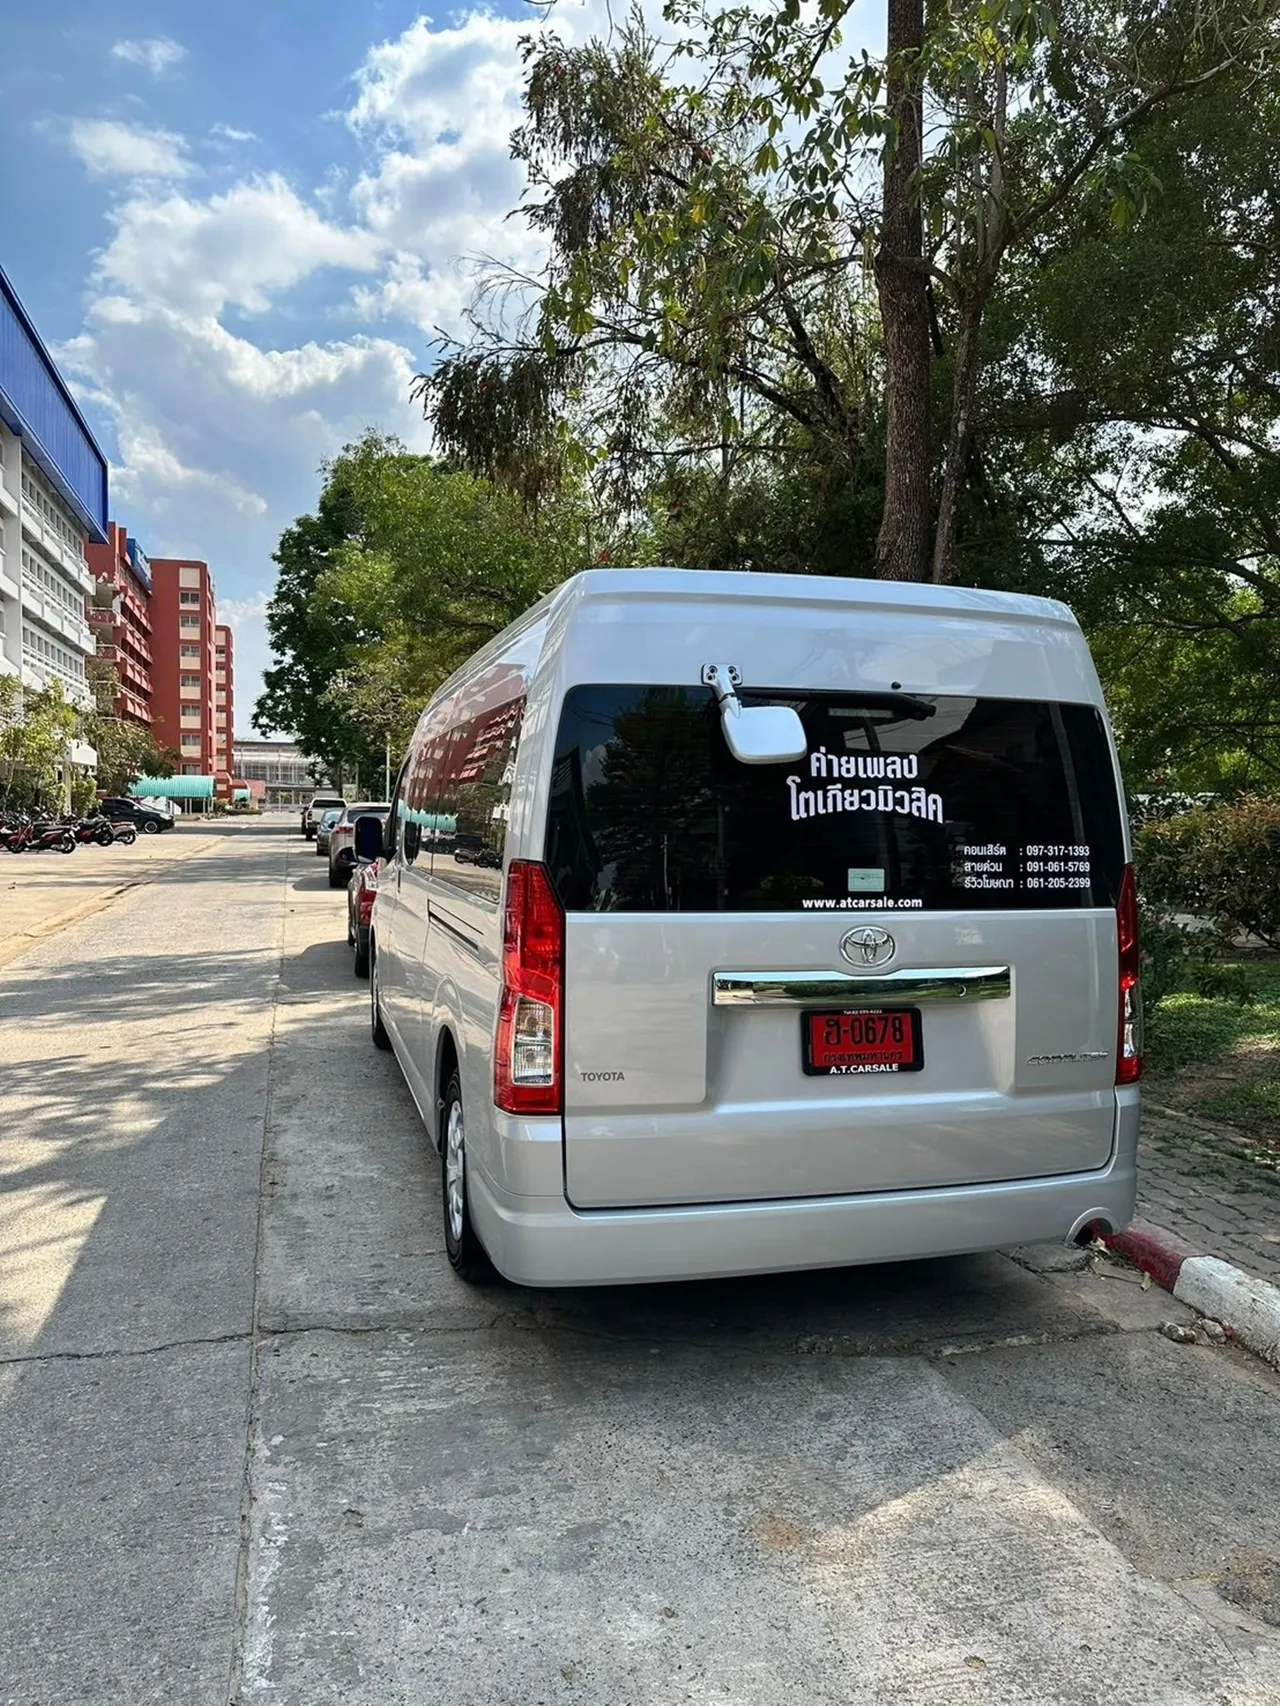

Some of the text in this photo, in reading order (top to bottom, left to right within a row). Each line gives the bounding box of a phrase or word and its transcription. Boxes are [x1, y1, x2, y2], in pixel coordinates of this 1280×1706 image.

[810, 746, 918, 779] ค่ายเพลง
[786, 775, 944, 824] โตเกียวมิวสิค
[1026, 845, 1090, 856] 097-317-1393
[963, 859, 1003, 872] สายด่วน
[1026, 861, 1091, 872] 091-061-5769
[963, 874, 1014, 889] รีวิวโฆษณา
[1026, 877, 1091, 888] 061-205-2399
[802, 896, 923, 908] www.atcarsale.com
[829, 1063, 899, 1075] A.T.CARSALE
[580, 1072, 625, 1081] TOYOTA
